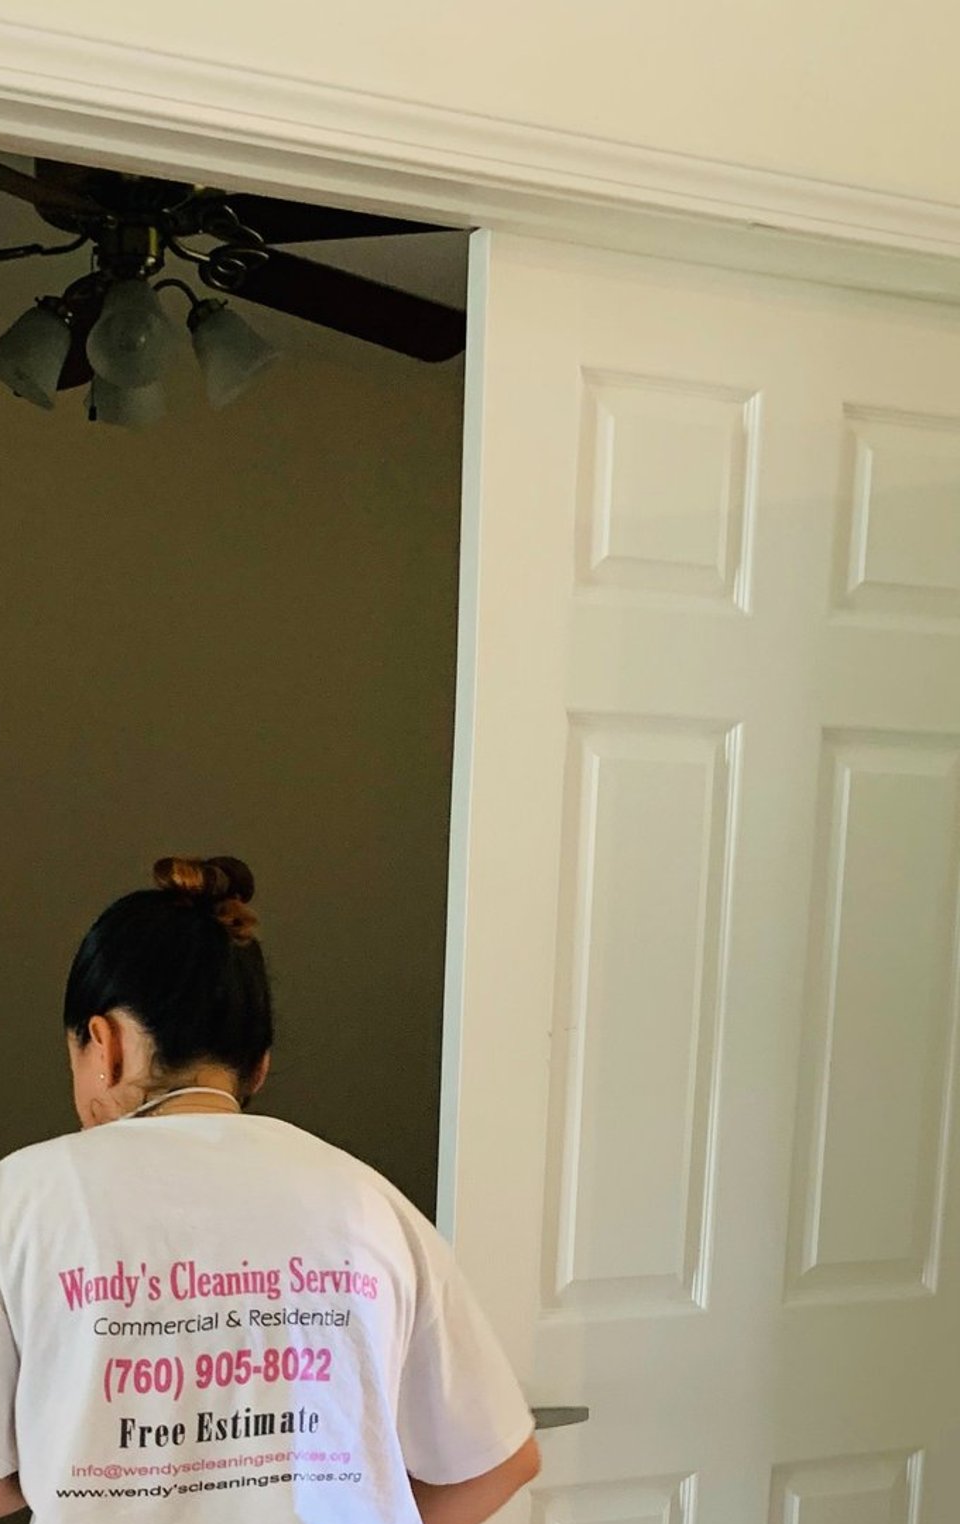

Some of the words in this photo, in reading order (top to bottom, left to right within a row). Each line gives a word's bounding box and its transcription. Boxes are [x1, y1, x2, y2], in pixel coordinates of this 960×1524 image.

[58, 1260, 161, 1311] Wendy's
[170, 1260, 281, 1300] Cleaning
[289, 1257, 378, 1300] Services
[93, 1312, 219, 1336] Commercial
[226, 1310, 242, 1328] &
[249, 1309, 351, 1328] Residential
[103, 1357, 184, 1402] (760)
[195, 1347, 332, 1389] 905-8022
[119, 1417, 186, 1449] Free
[195, 1406, 320, 1443] Estimate
